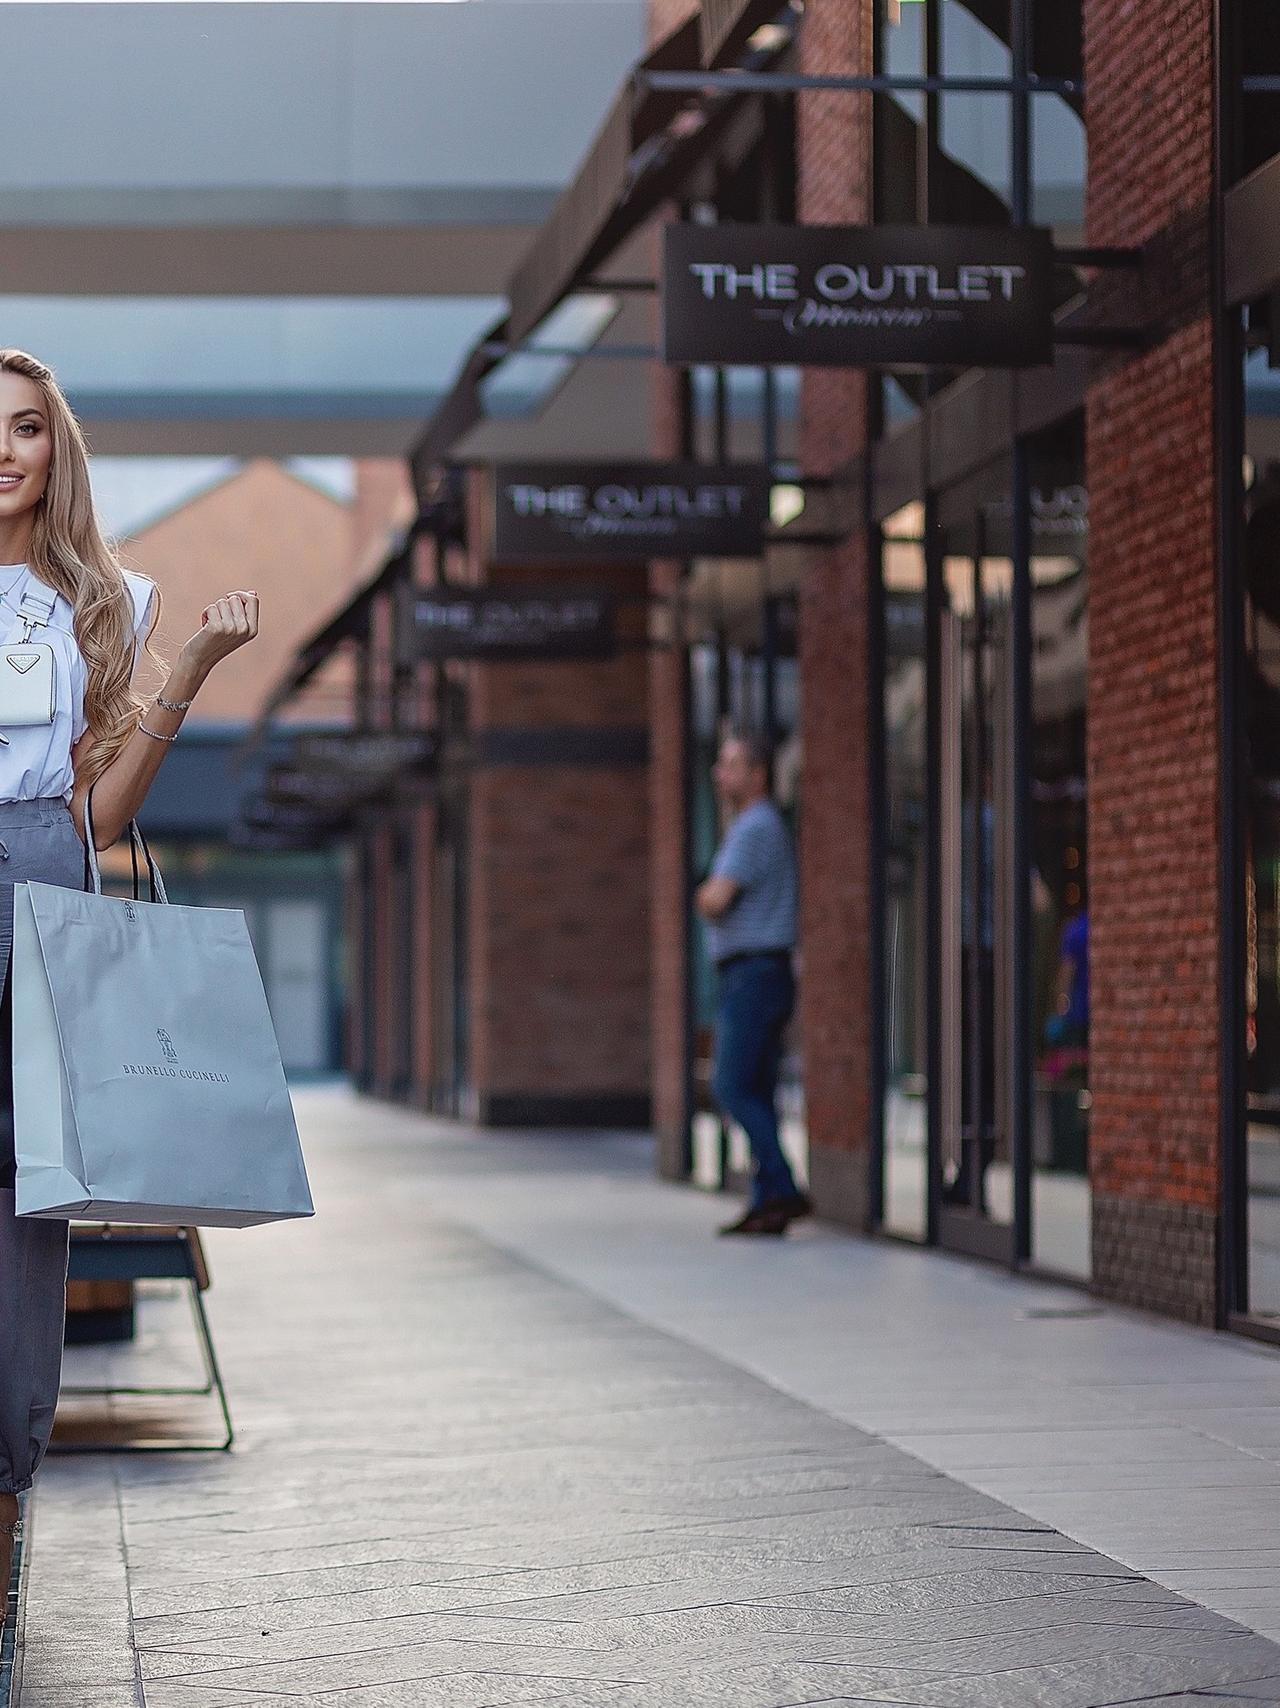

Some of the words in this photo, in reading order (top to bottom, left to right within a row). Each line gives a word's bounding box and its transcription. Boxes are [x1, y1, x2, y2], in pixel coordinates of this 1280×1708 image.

[689, 264, 800, 299] THE
[815, 264, 1026, 300] OUTLET
[506, 484, 588, 518] THE
[593, 484, 745, 519] OUTLET
[122, 1064, 176, 1077] BRUNELLO
[179, 1069, 230, 1083] CUCINELLI
